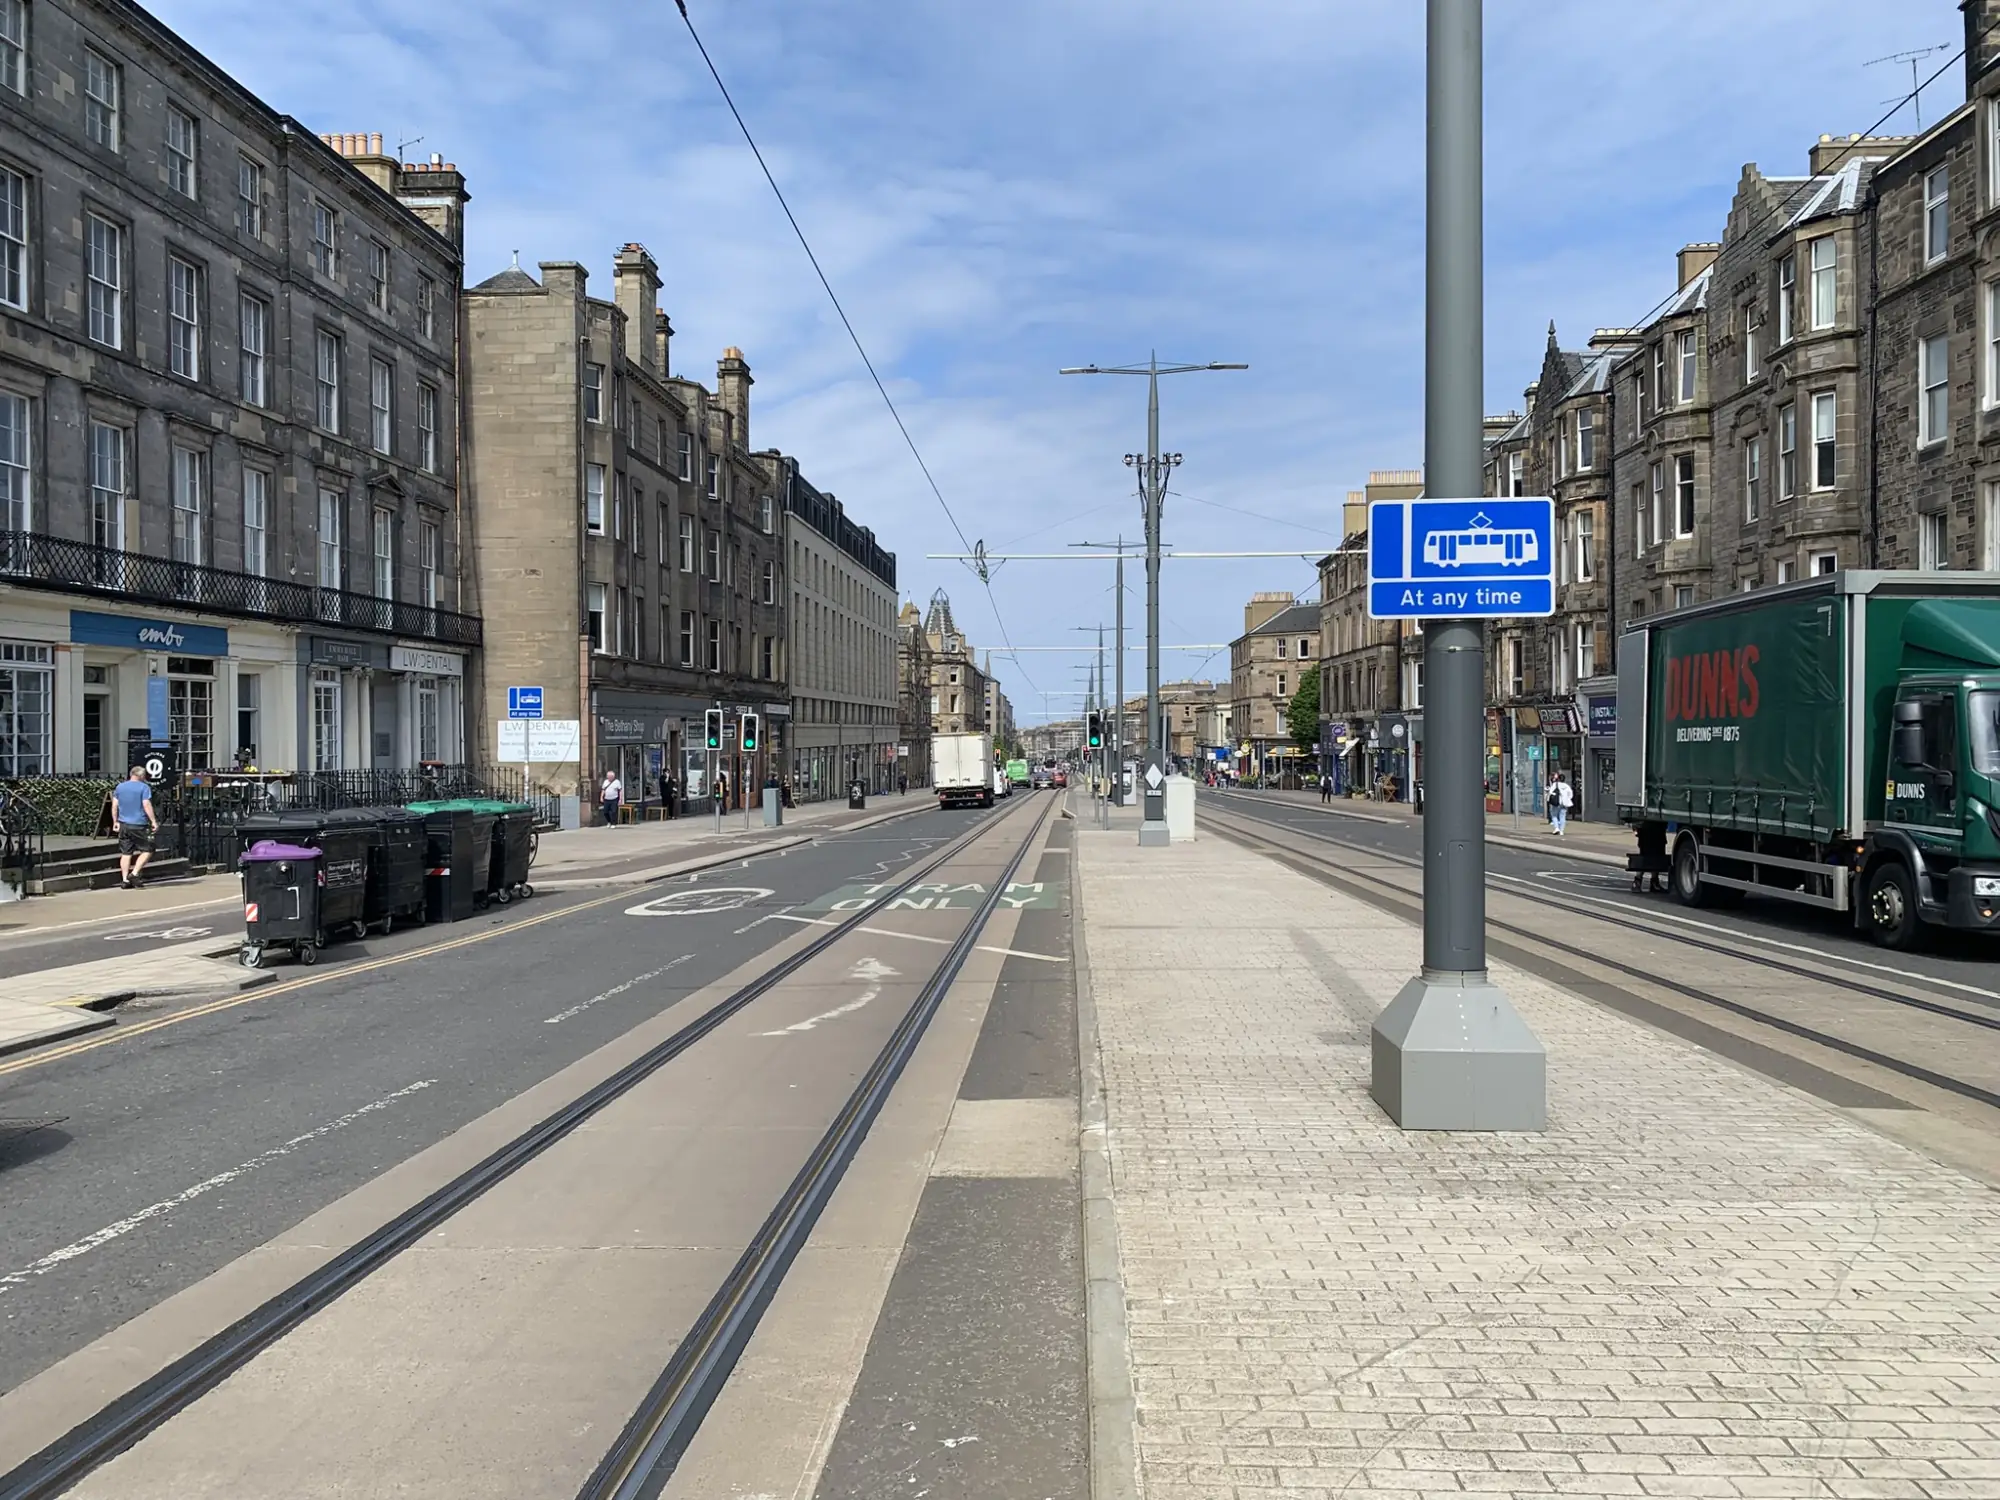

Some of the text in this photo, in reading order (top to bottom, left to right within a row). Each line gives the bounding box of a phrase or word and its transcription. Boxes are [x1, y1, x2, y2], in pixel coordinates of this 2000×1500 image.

[1400, 588, 1522, 609] At any time
[139, 624, 185, 647] embo
[420, 653, 453, 672] DENTAL
[1666, 645, 1760, 721] DUNNS
[504, 722, 573, 731] LW DENTAL
[604, 718, 645, 735] The Bethany Shop
[1676, 726, 1712, 742] DELIVERING
[1723, 726, 1740, 742] 1875
[1896, 783, 1925, 799] DUNNS
[862, 883, 1044, 895] TRAM
[830, 897, 1039, 911] ONLY
